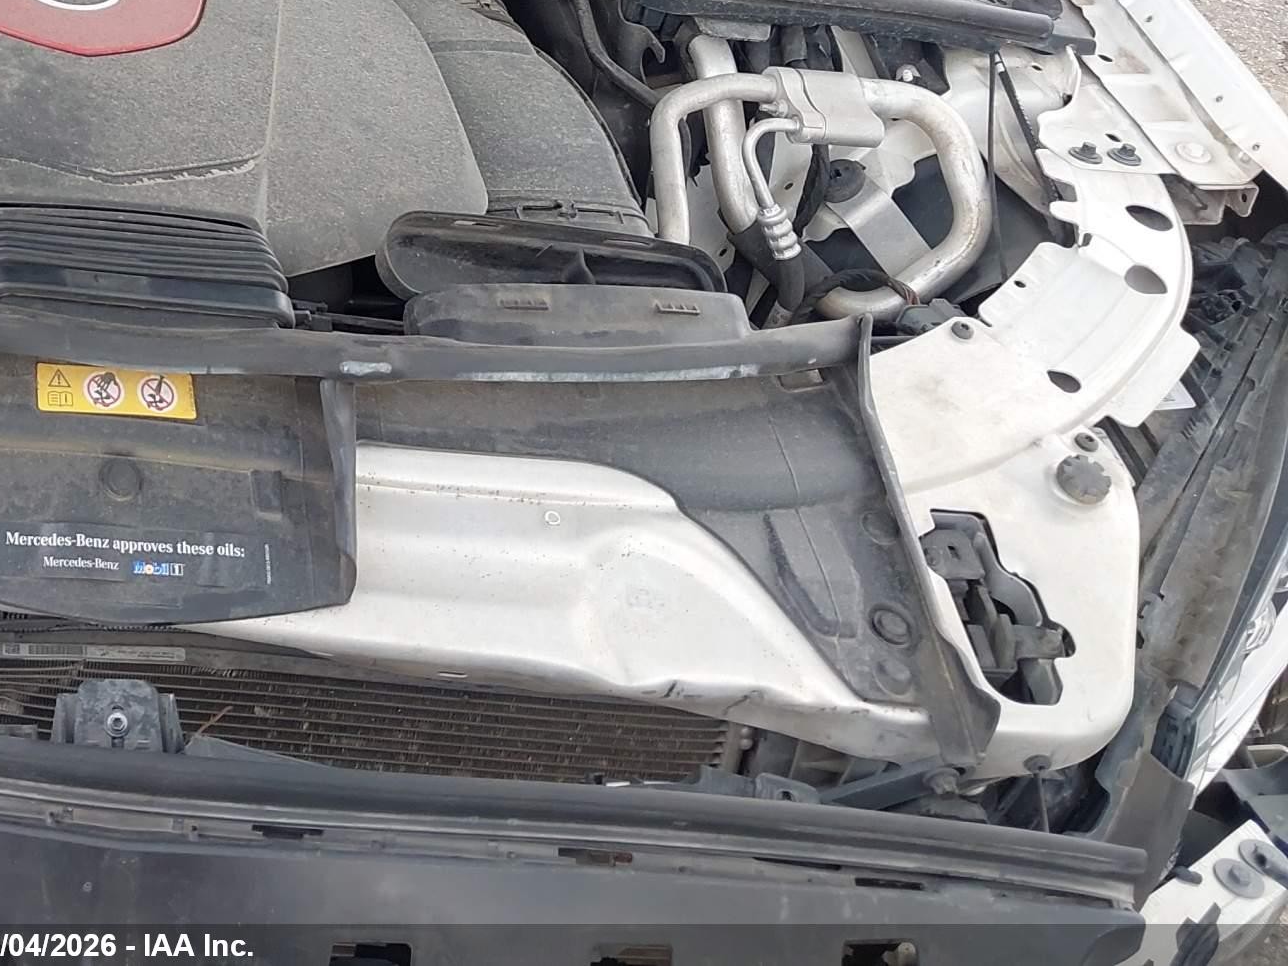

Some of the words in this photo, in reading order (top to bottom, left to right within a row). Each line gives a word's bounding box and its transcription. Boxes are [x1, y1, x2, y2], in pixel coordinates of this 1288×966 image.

[5, 531, 110, 550] Mercedes-Benz
[112, 538, 174, 554] approves
[176, 540, 214, 556] these
[216, 542, 246, 558] oils:
[42, 555, 120, 571] Mercedes-Benz
